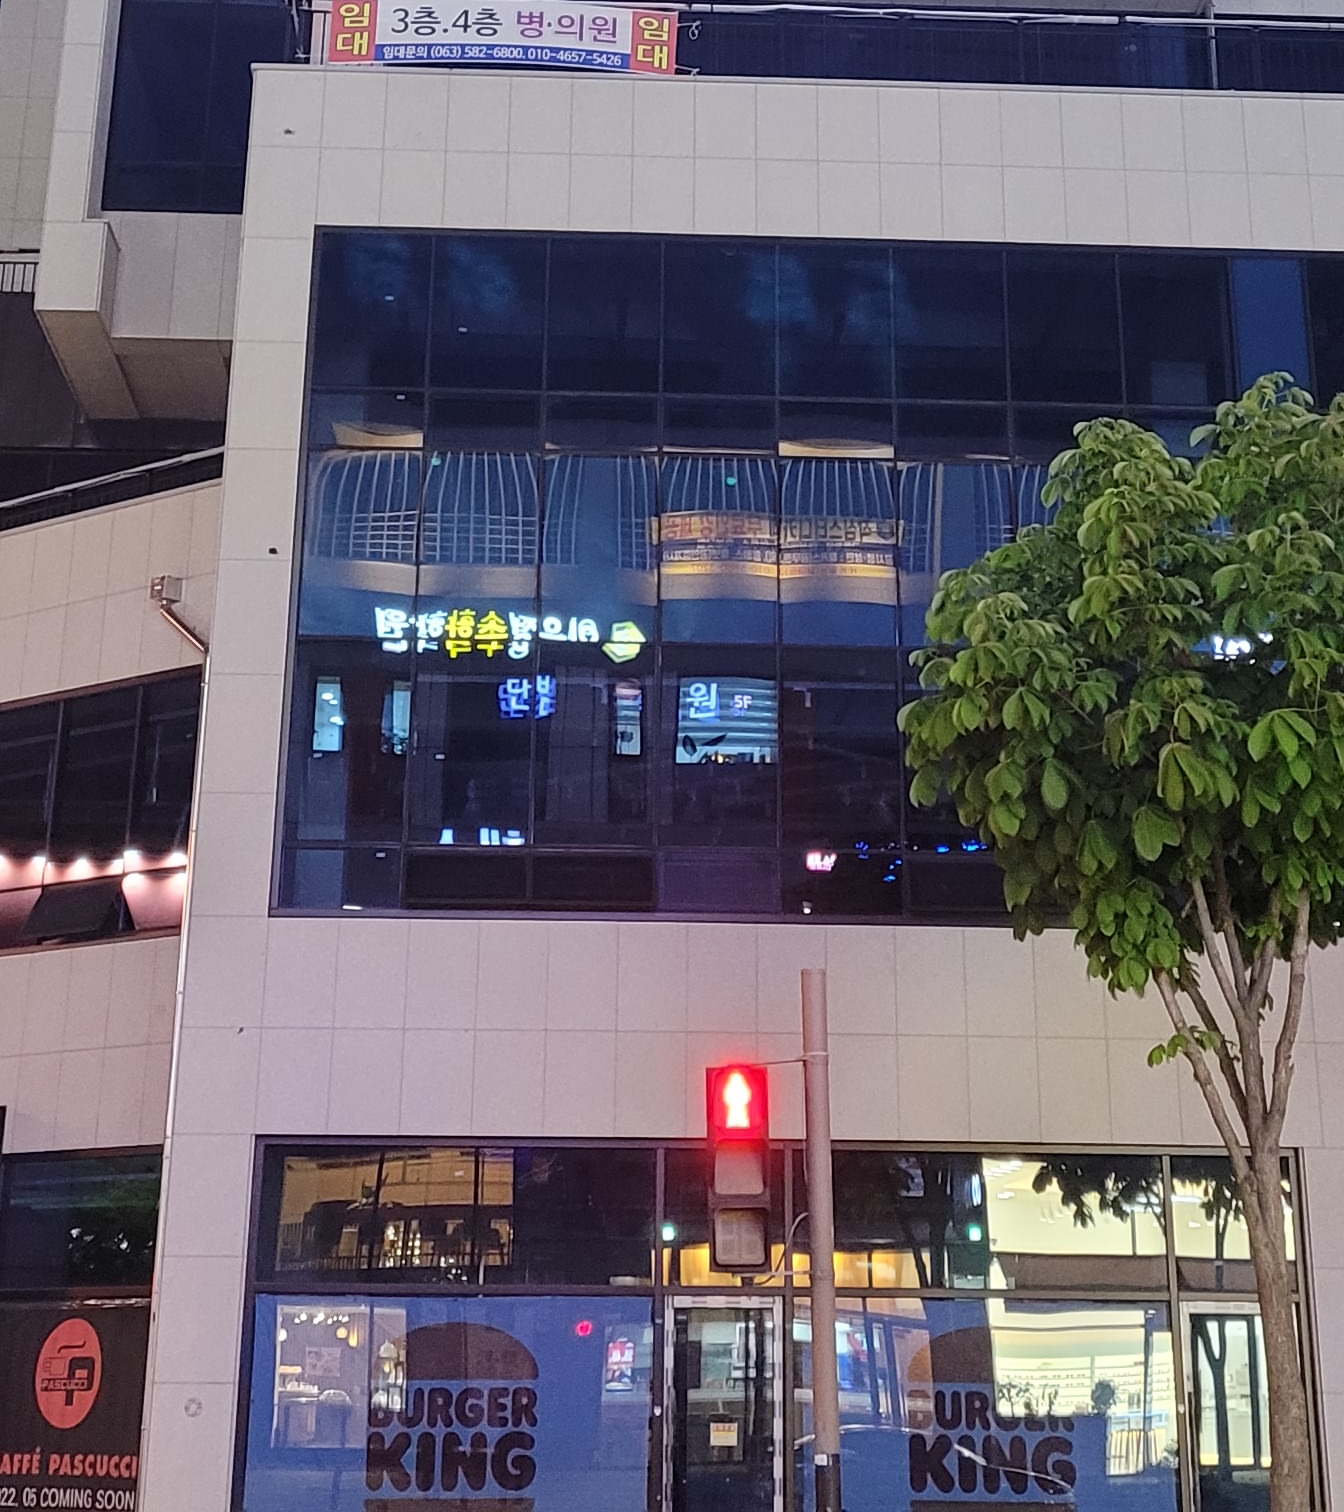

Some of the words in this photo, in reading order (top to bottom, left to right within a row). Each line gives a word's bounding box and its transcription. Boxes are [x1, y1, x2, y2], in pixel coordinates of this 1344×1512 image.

[383, 46, 428, 59] 임대문의
[430, 46, 462, 59] (063)
[527, 47, 622, 66] 010-4657-5426
[48, 1453, 138, 1478] PASCUCCI
[366, 1431, 537, 1491] KING
[908, 1433, 1077, 1495] KING
[22, 1487, 37, 1507] 05
[40, 1487, 93, 1509] COMING
[95, 1489, 135, 1511] SOON
